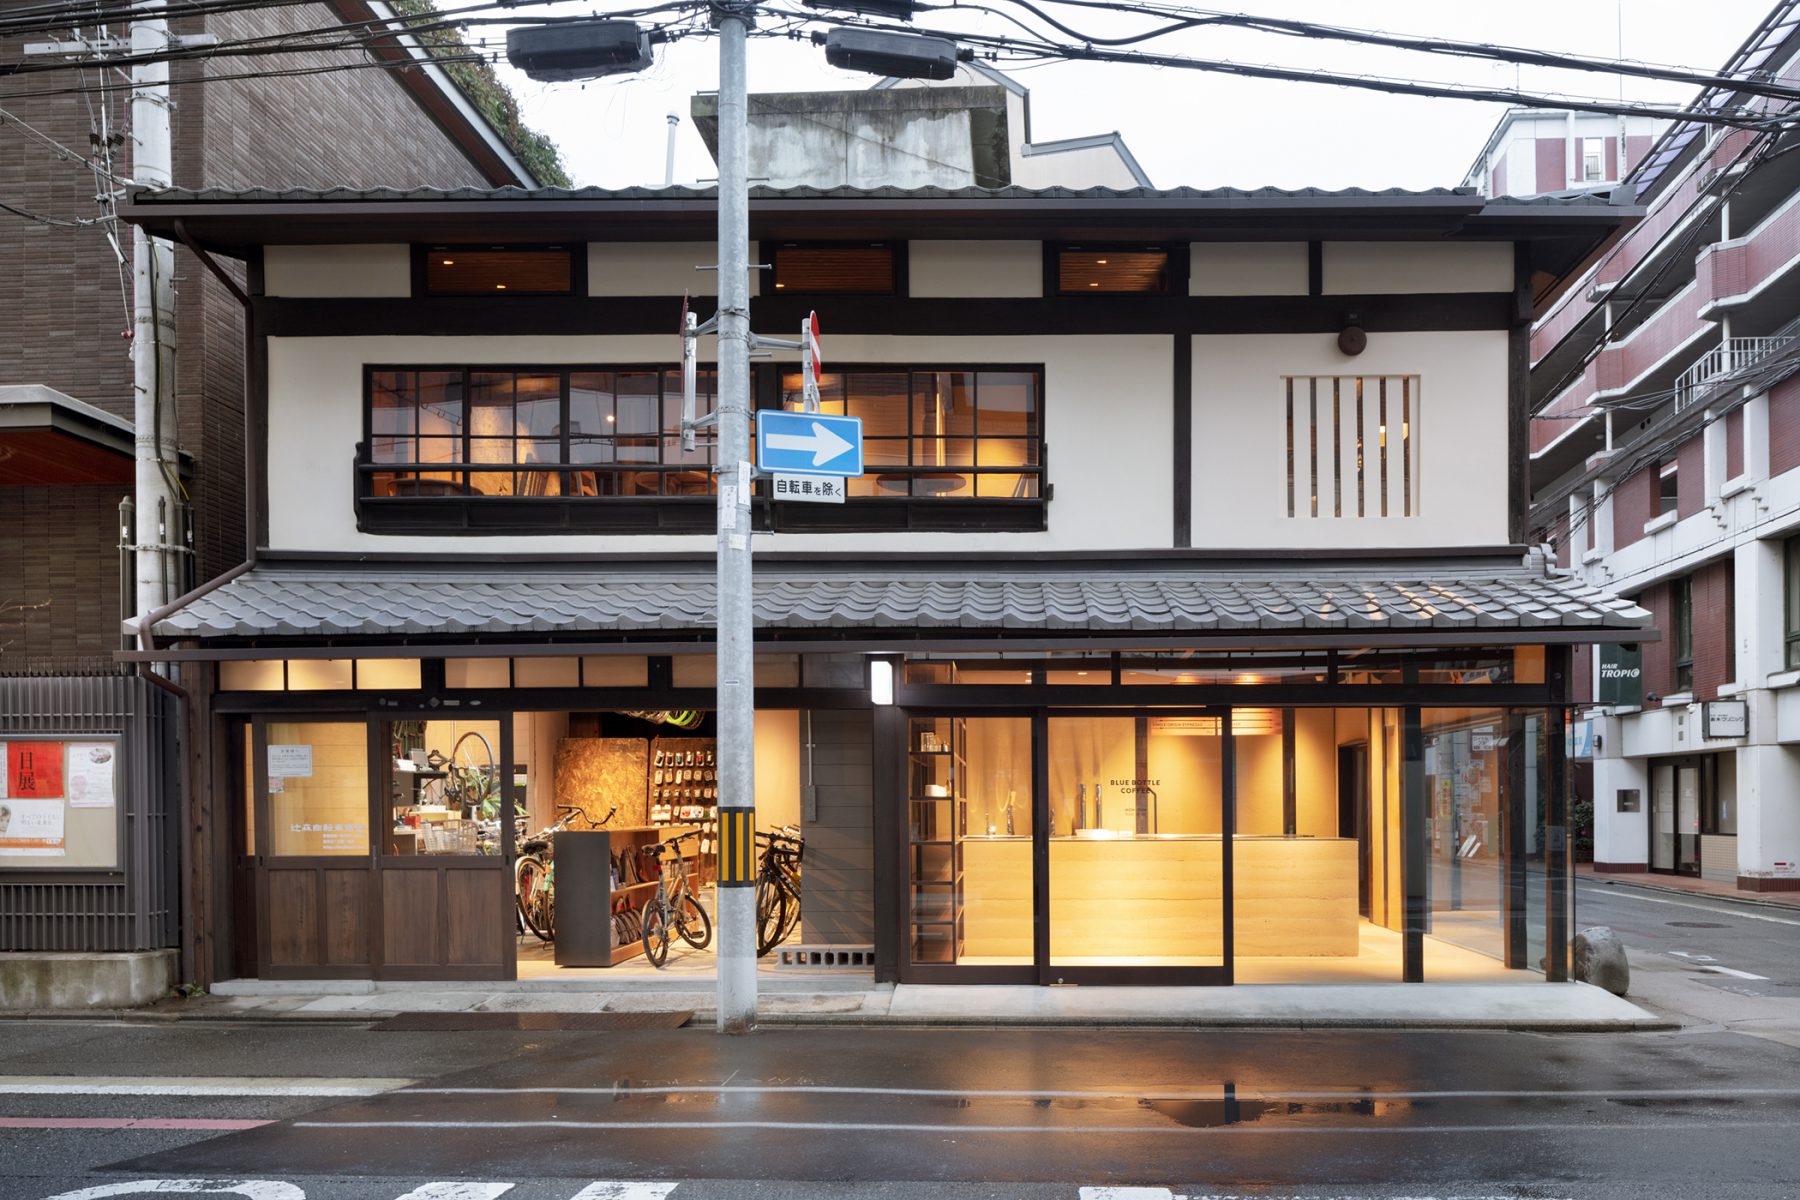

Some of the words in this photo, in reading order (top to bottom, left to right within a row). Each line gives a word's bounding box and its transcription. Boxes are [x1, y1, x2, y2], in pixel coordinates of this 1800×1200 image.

[777, 480, 842, 497] 自転車を除く
[19, 751, 36, 790] 日展
